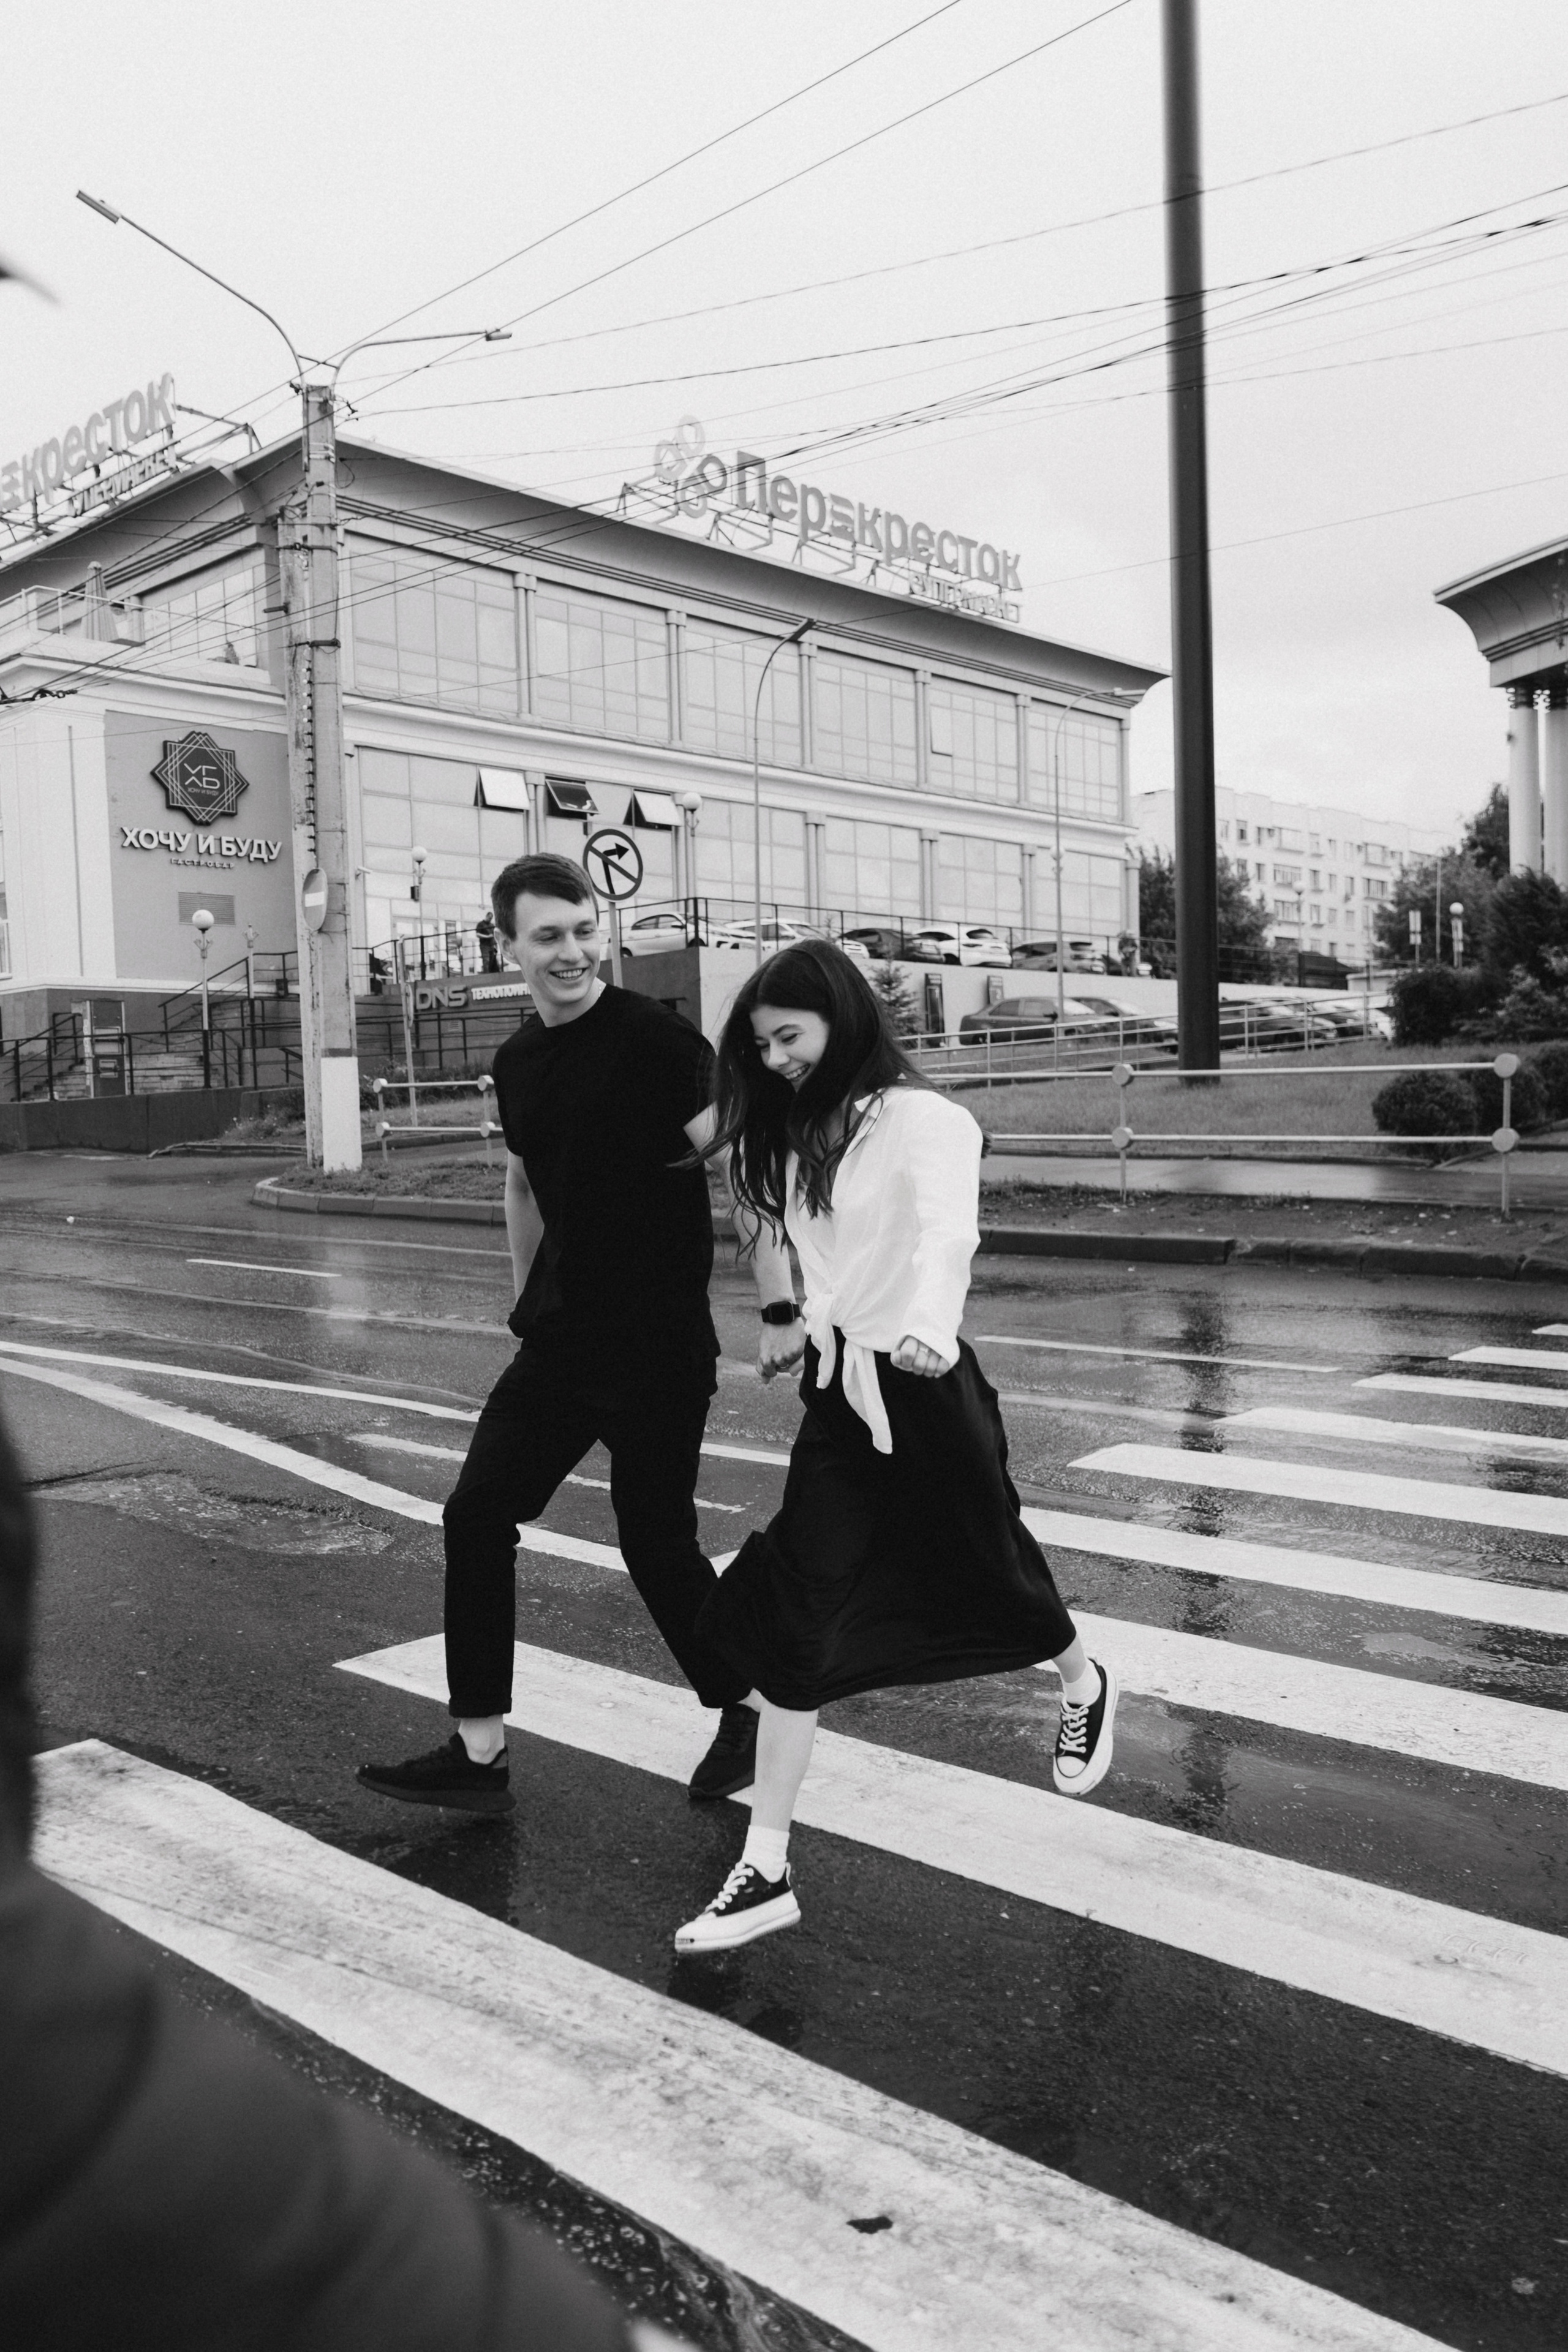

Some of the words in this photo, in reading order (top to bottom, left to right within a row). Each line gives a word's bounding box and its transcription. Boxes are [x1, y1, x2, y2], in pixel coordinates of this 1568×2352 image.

[122, 827, 192, 853] ХОЧУ
[197, 834, 214, 854] И
[221, 835, 282, 863] БУДУ
[171, 858, 234, 869] ГАСТРОБАР
[416, 986, 467, 1009] DNS
[471, 982, 531, 1000] ТЕХНОПОИН
